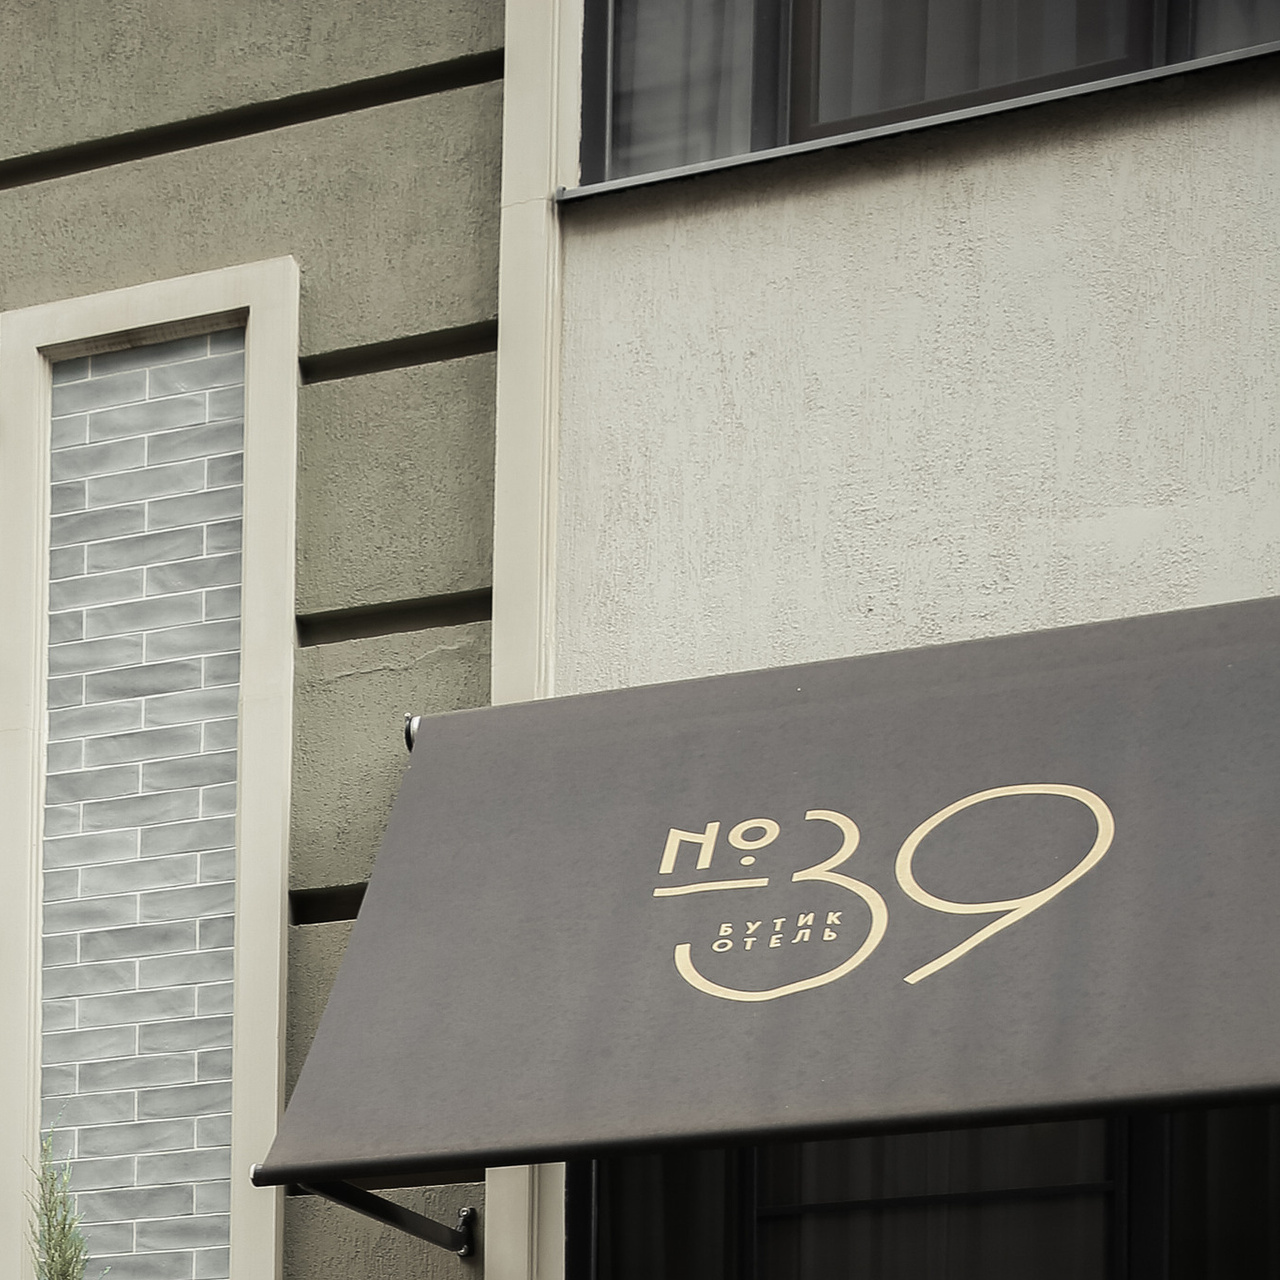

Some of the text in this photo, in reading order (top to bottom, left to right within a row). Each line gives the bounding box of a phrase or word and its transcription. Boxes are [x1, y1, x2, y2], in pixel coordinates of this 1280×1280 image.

[674, 783, 1115, 1002] 39
[718, 911, 843, 936] БУТИК
[712, 928, 838, 952] ОТЕЛЬ
